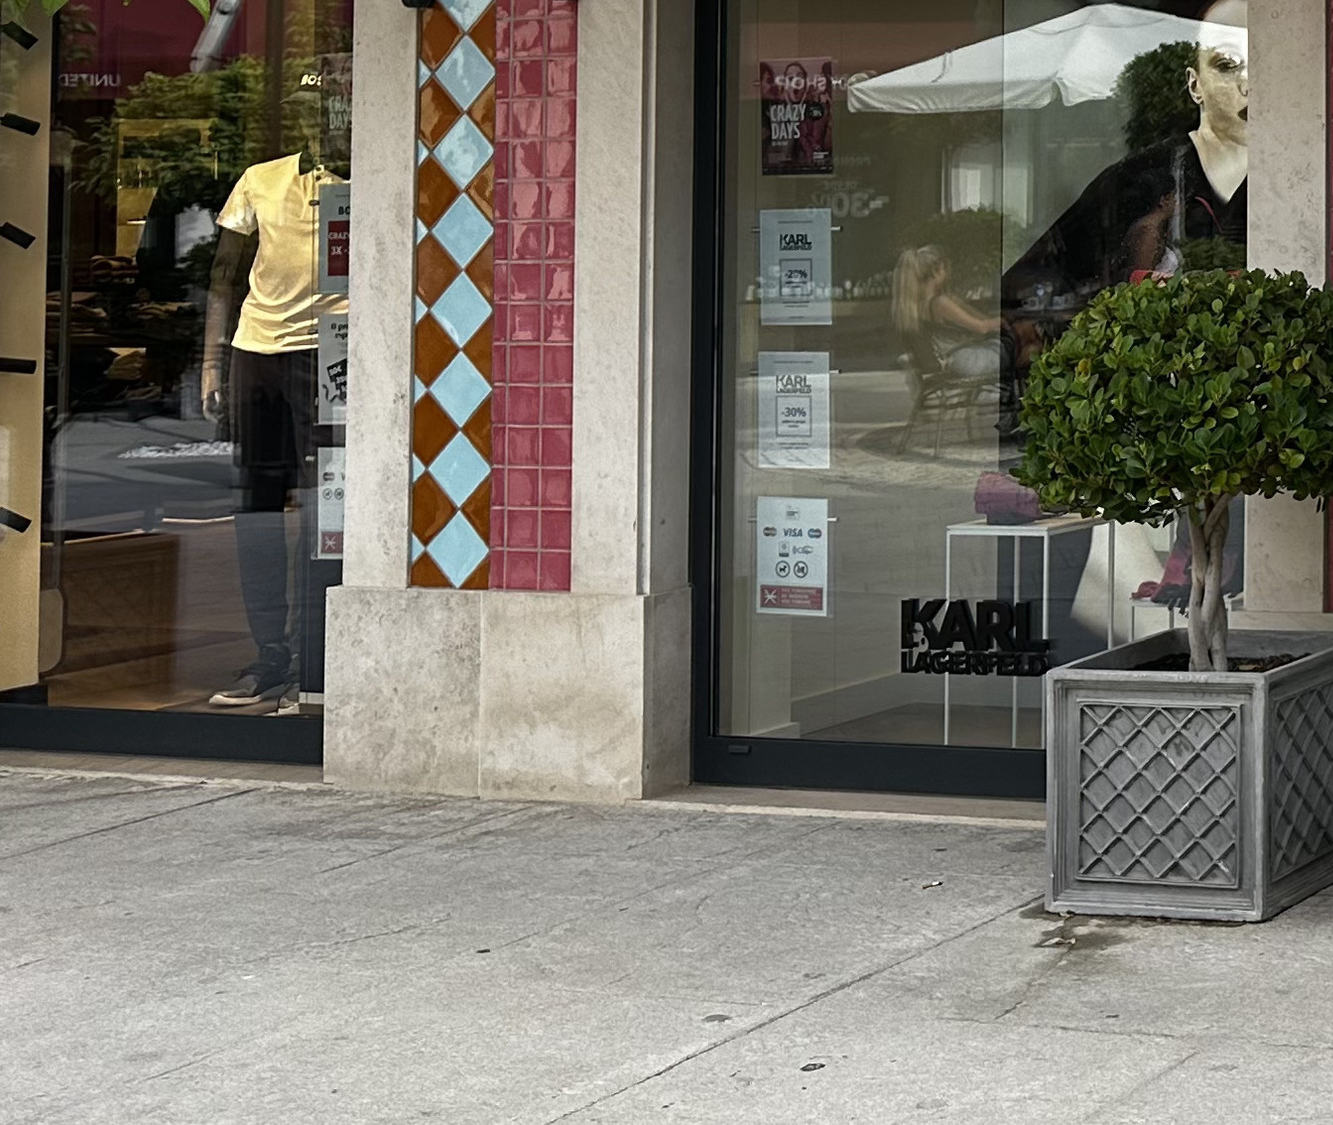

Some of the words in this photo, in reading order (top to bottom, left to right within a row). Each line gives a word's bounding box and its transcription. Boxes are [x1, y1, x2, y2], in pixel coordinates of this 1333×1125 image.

[328, 96, 350, 112] CRA
[329, 113, 351, 129] DAY
[769, 104, 806, 122] CRAZY
[771, 122, 801, 140] DAYS
[780, 234, 812, 245] KARL
[776, 375, 811, 387] KARL
[781, 407, 807, 417] -30%
[783, 528, 803, 537] VISA
[901, 598, 1050, 652] KARL
[901, 650, 1050, 676] LAGERFELD
